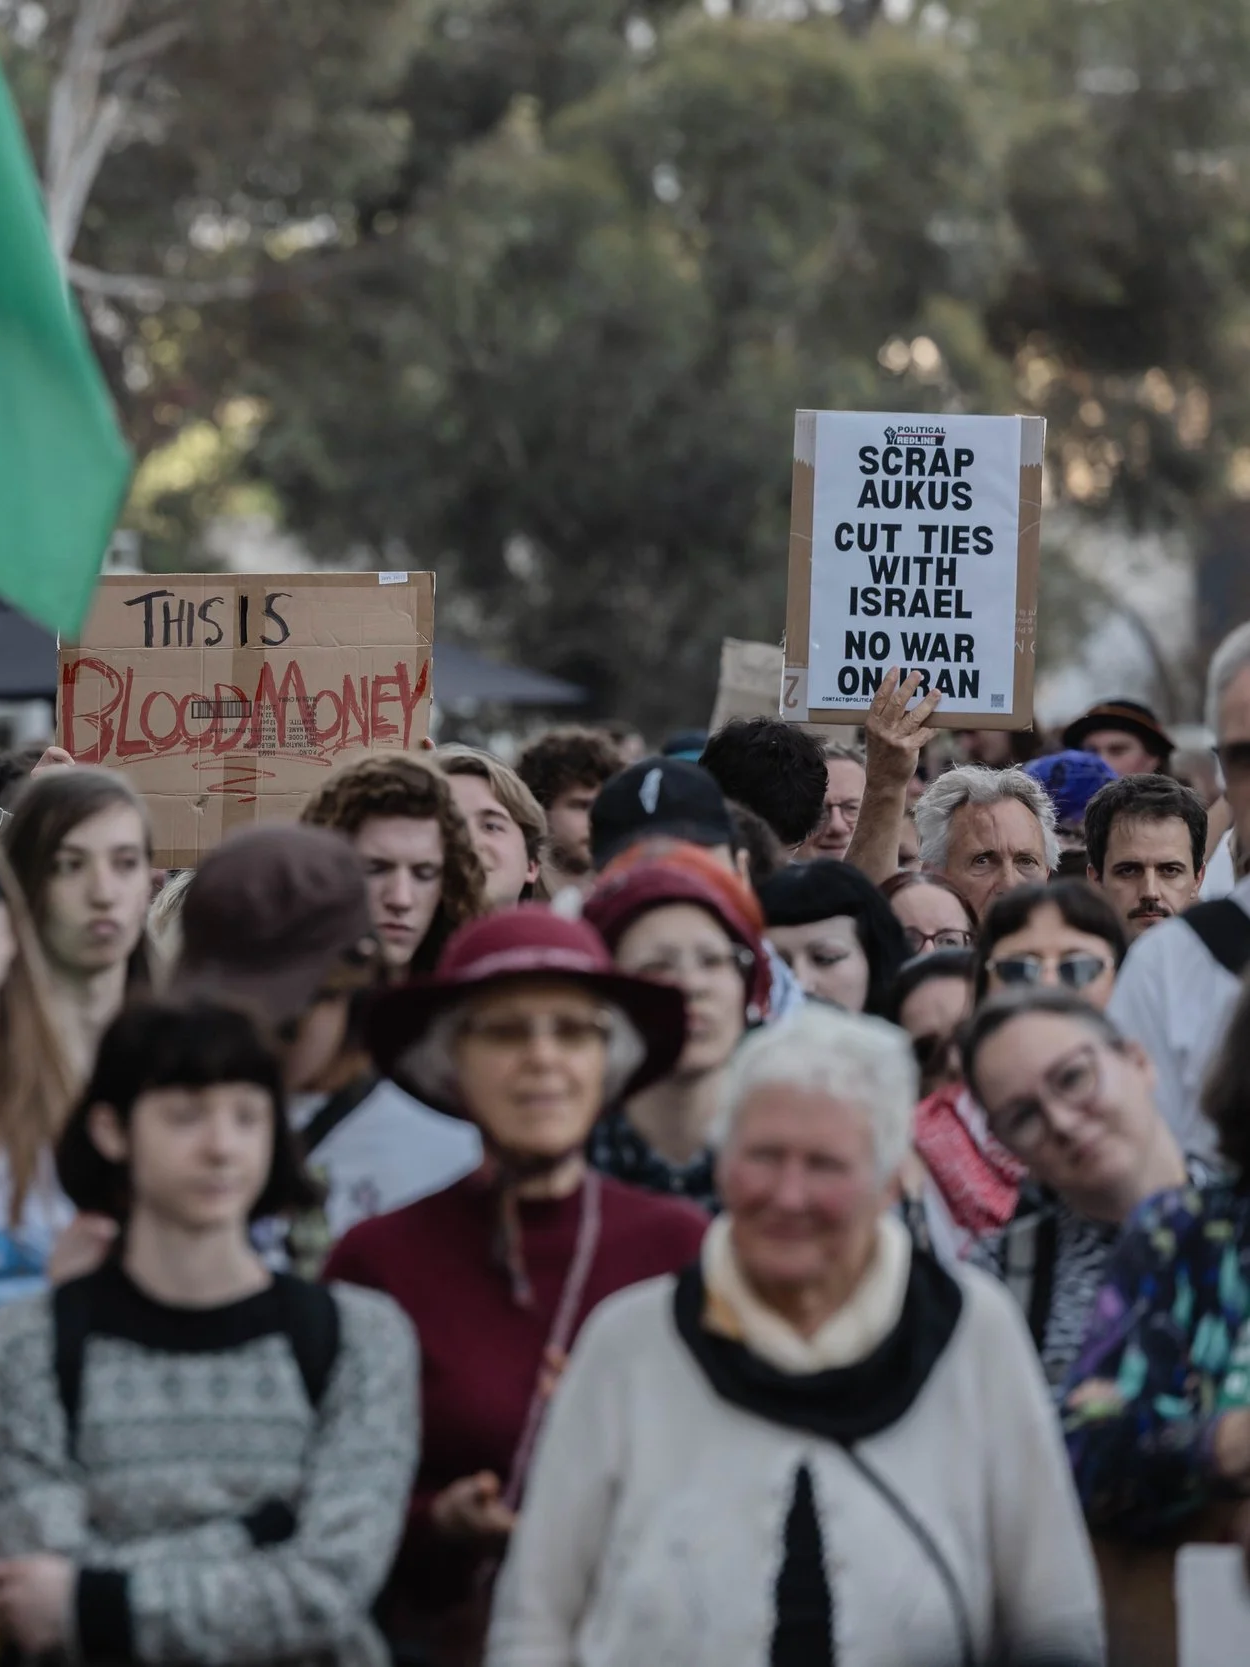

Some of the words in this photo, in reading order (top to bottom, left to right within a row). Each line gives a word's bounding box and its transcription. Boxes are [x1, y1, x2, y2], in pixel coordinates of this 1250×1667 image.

[896, 436, 937, 445] REDLINE
[897, 426, 946, 434] POLITICAL
[858, 446, 974, 477] SCRAP
[857, 480, 972, 510] AUKUS
[834, 522, 902, 552] CUT
[918, 524, 994, 555] TIES
[868, 555, 957, 586] WITH
[850, 587, 972, 619] ISRAEL
[124, 590, 224, 648] THIS
[239, 592, 293, 647] IS
[844, 630, 890, 660] NO
[900, 632, 974, 663] WAR
[838, 666, 883, 695] ON
